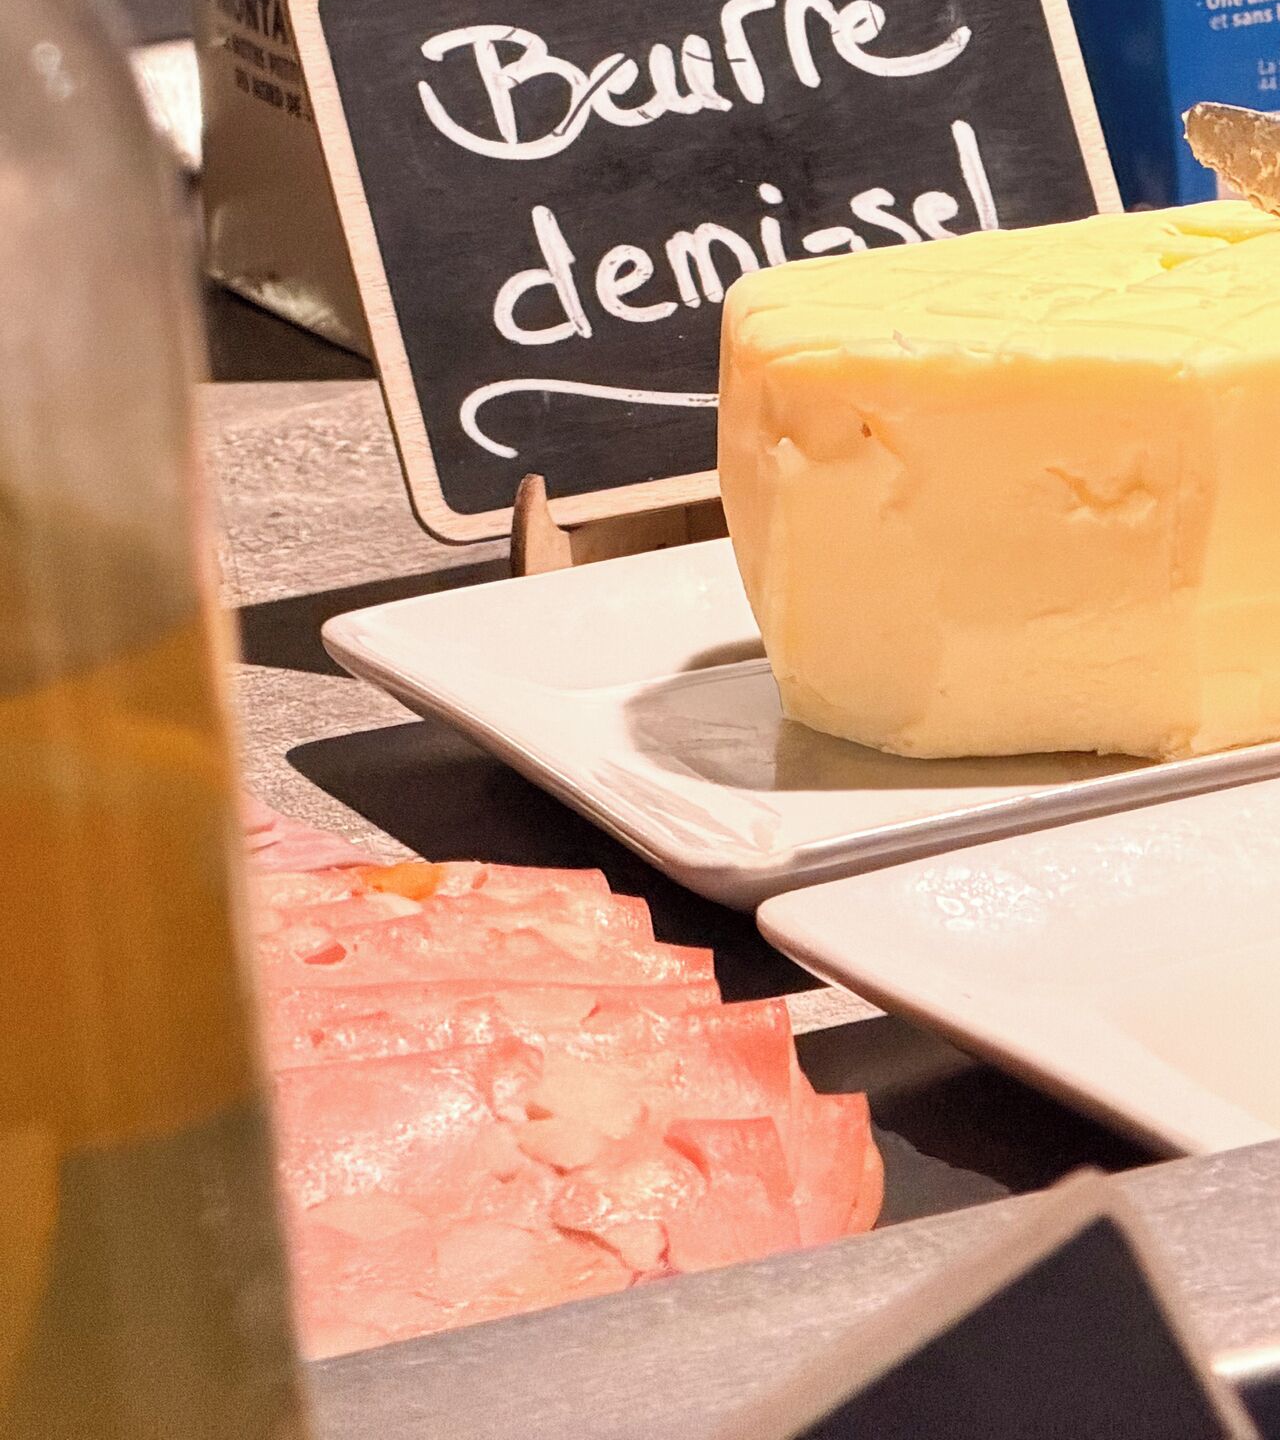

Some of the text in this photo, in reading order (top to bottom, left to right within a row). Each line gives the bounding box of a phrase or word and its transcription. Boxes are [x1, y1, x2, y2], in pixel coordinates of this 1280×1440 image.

[1208, 14, 1230, 31] et
[1232, 7, 1274, 28] sans
[493, 119, 1000, 347] demi-sel
